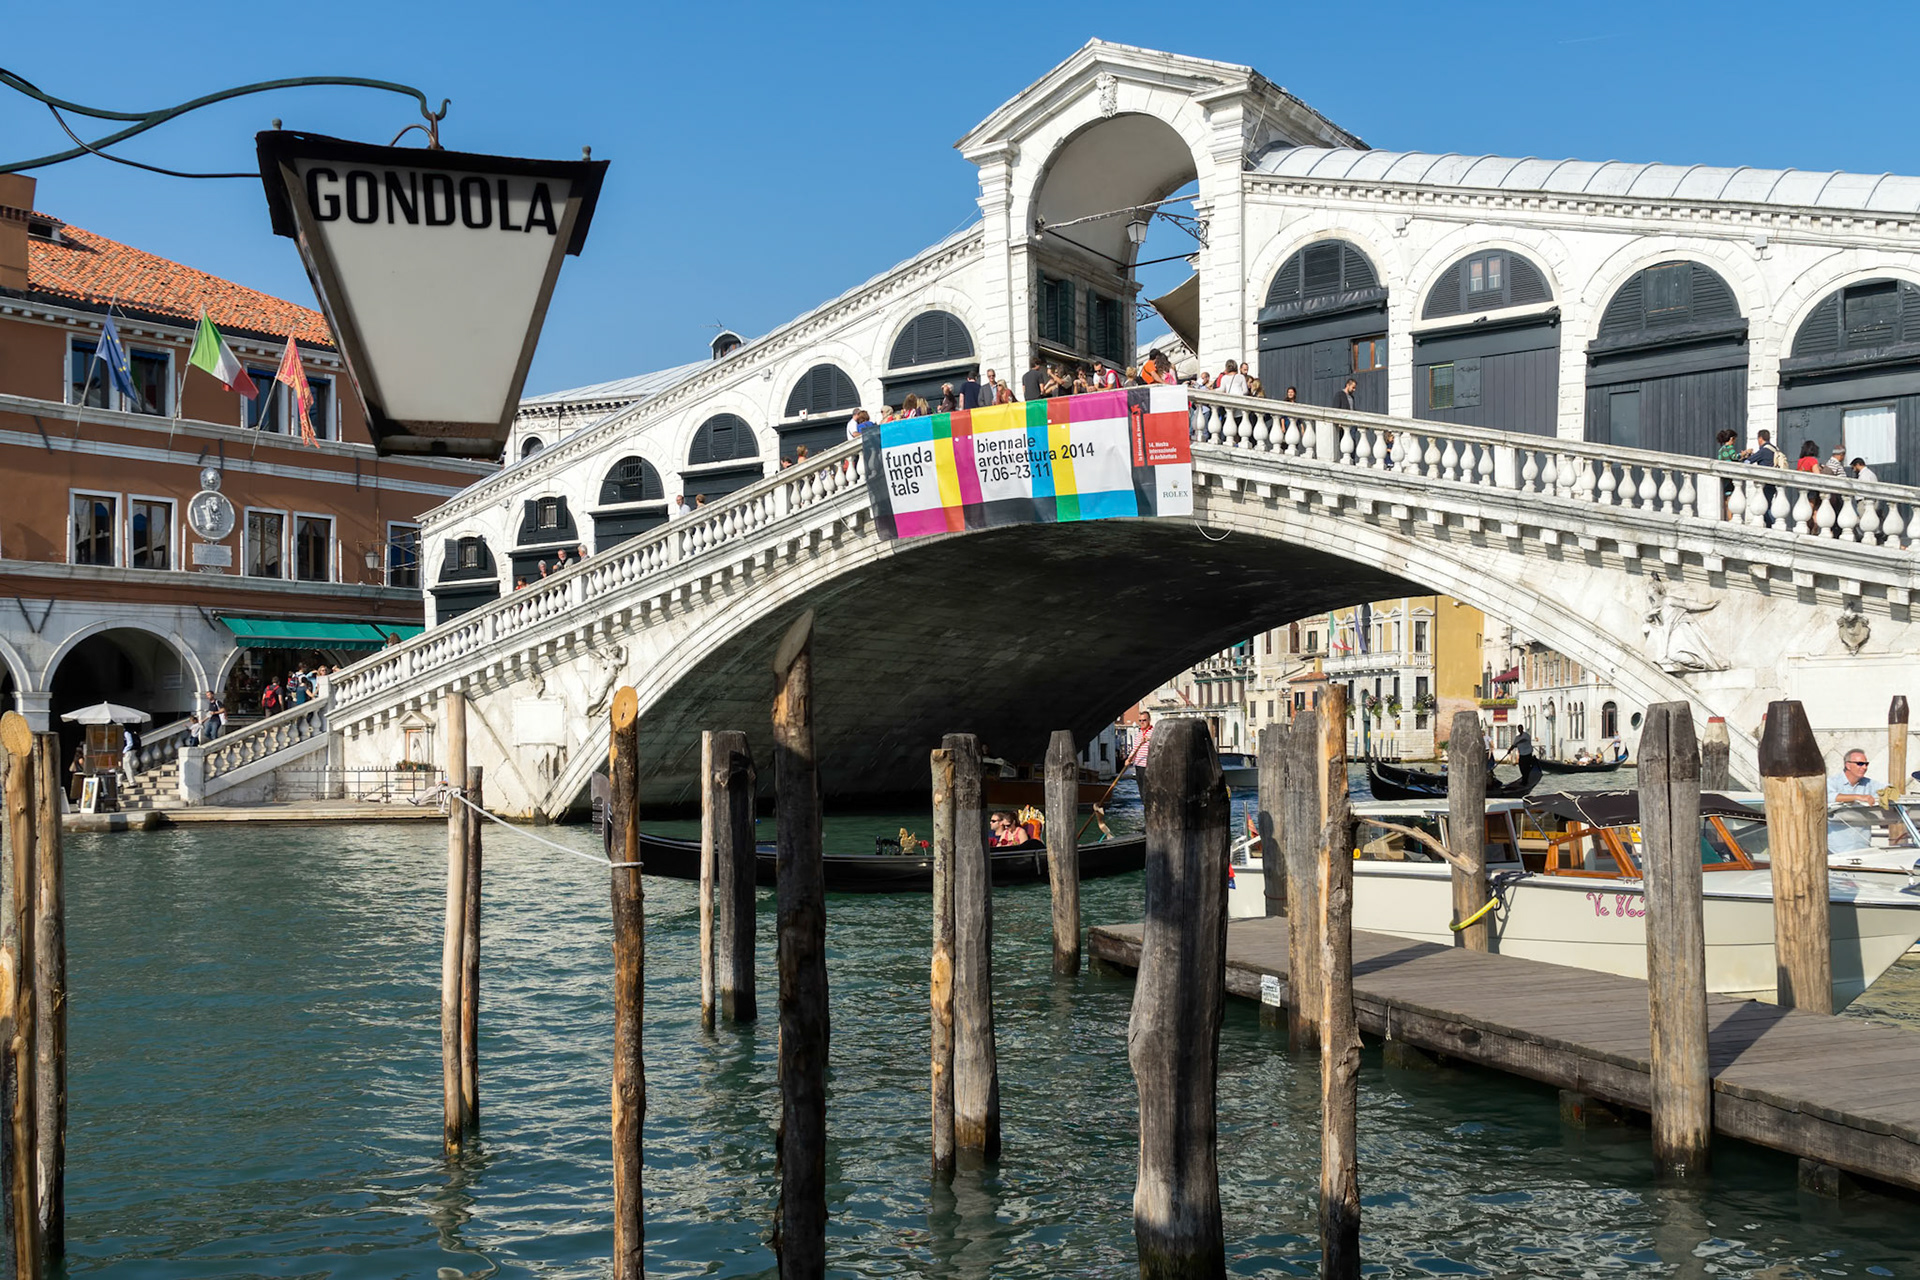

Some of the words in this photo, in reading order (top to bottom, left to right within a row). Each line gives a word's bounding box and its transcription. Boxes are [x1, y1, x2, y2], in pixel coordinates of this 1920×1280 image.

[305, 167, 558, 236] GONDOLA
[977, 433, 1036, 453] biennale
[1060, 442, 1095, 459] 2014
[885, 446, 933, 468] funda
[889, 464, 924, 481] men
[891, 478, 920, 497] tals
[1162, 490, 1189, 499] ROLEX
